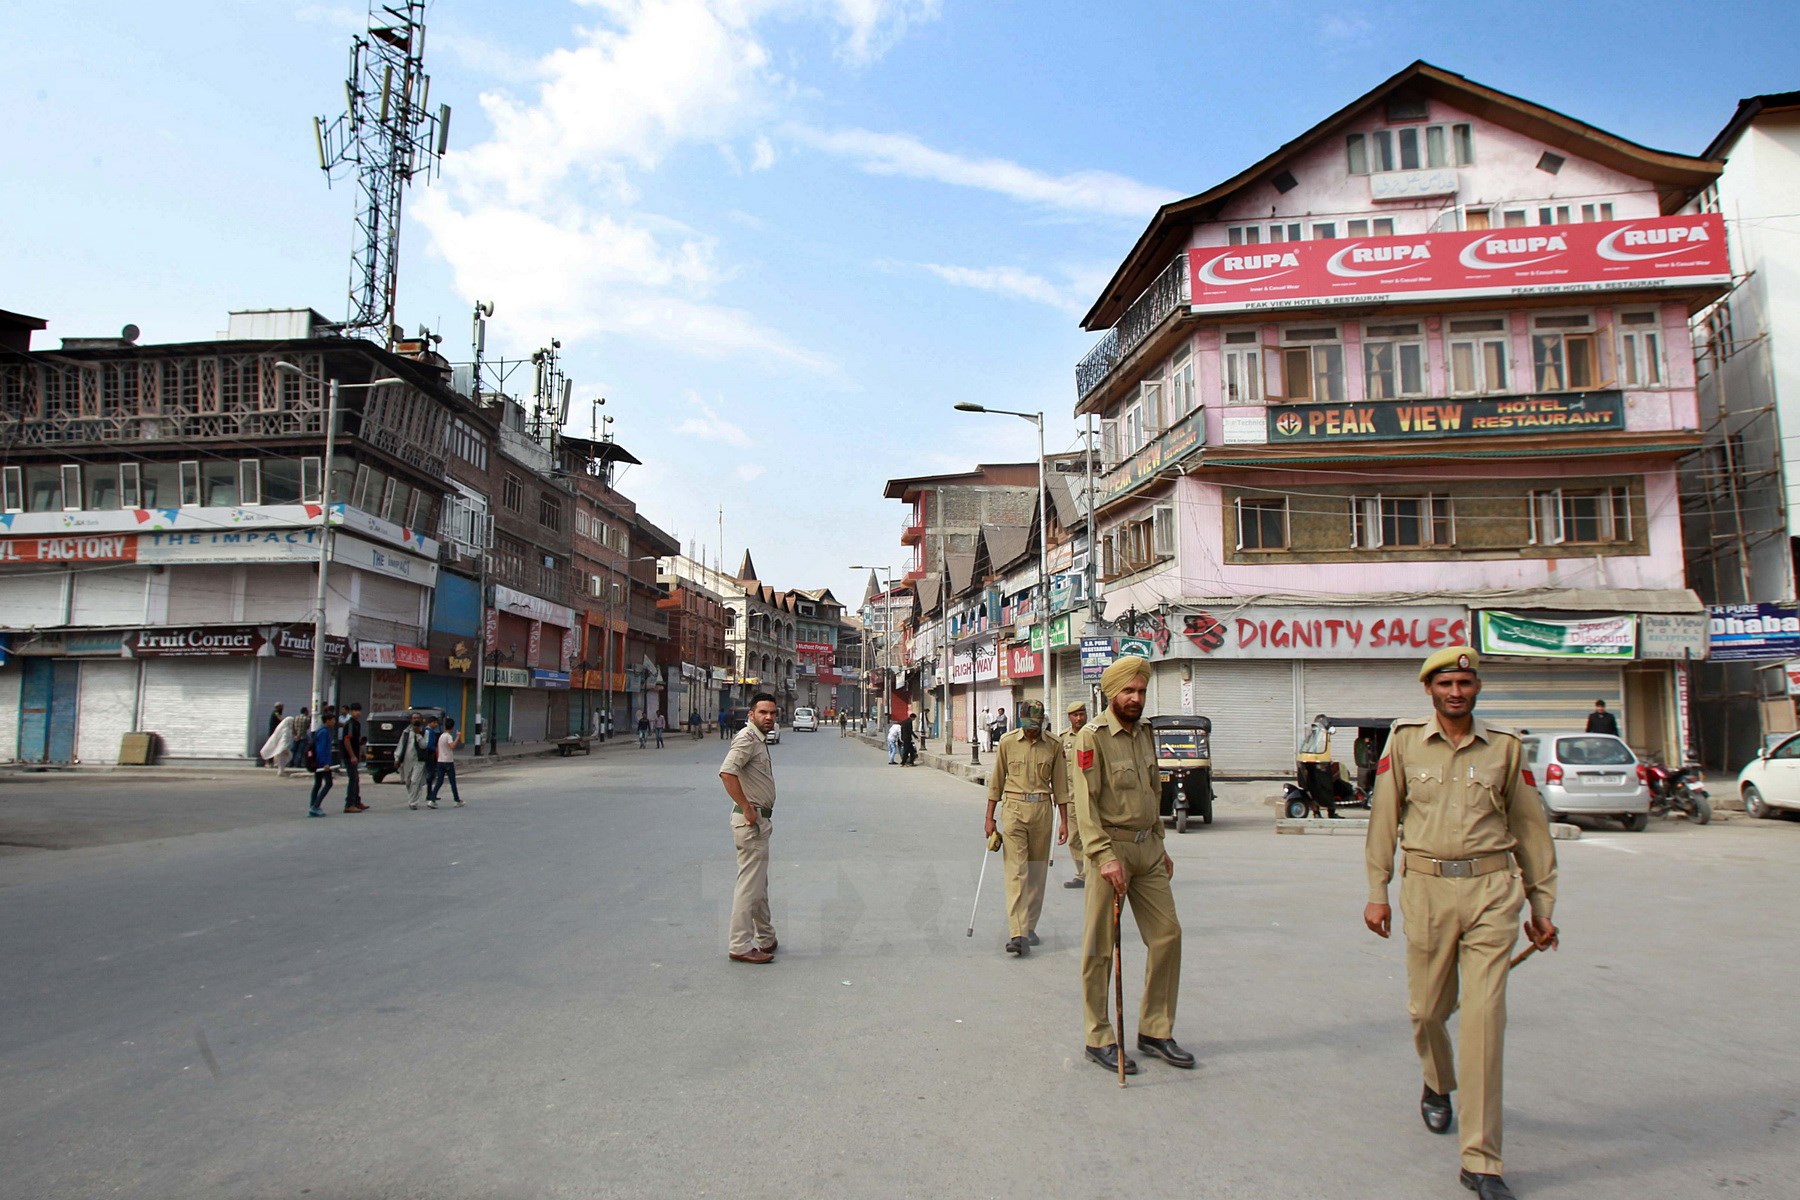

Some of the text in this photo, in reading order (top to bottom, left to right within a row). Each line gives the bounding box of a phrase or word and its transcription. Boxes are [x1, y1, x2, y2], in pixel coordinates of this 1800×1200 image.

[1624, 226, 1709, 246] RUPA
[1353, 244, 1431, 263] RUPA
[1486, 236, 1568, 255] RUPA
[1224, 253, 1300, 271] RUPA
[1510, 286, 1534, 294] PEAK
[1563, 284, 1592, 292] HOTEL
[1604, 279, 1666, 288] RESTAURANT
[1333, 295, 1390, 303] RESTAURANT
[1497, 400, 1568, 413] HOTEL
[1309, 405, 1613, 435] PEAK VIEW RESTAURANT
[37, 536, 126, 559] FACTORY
[152, 533, 200, 545] THE
[372, 549, 385, 567] THE
[1726, 604, 1759, 614] PURE
[1236, 618, 1364, 649] DIGNITY
[1369, 617, 1467, 648] SALES
[1709, 615, 1800, 635] Dhaba
[137, 629, 253, 647] Fruit Corner
[279, 630, 310, 650] Fruit
[1571, 632, 1630, 643] Discount
[977, 657, 994, 673] WAY
[1014, 648, 1035, 674] Bata
